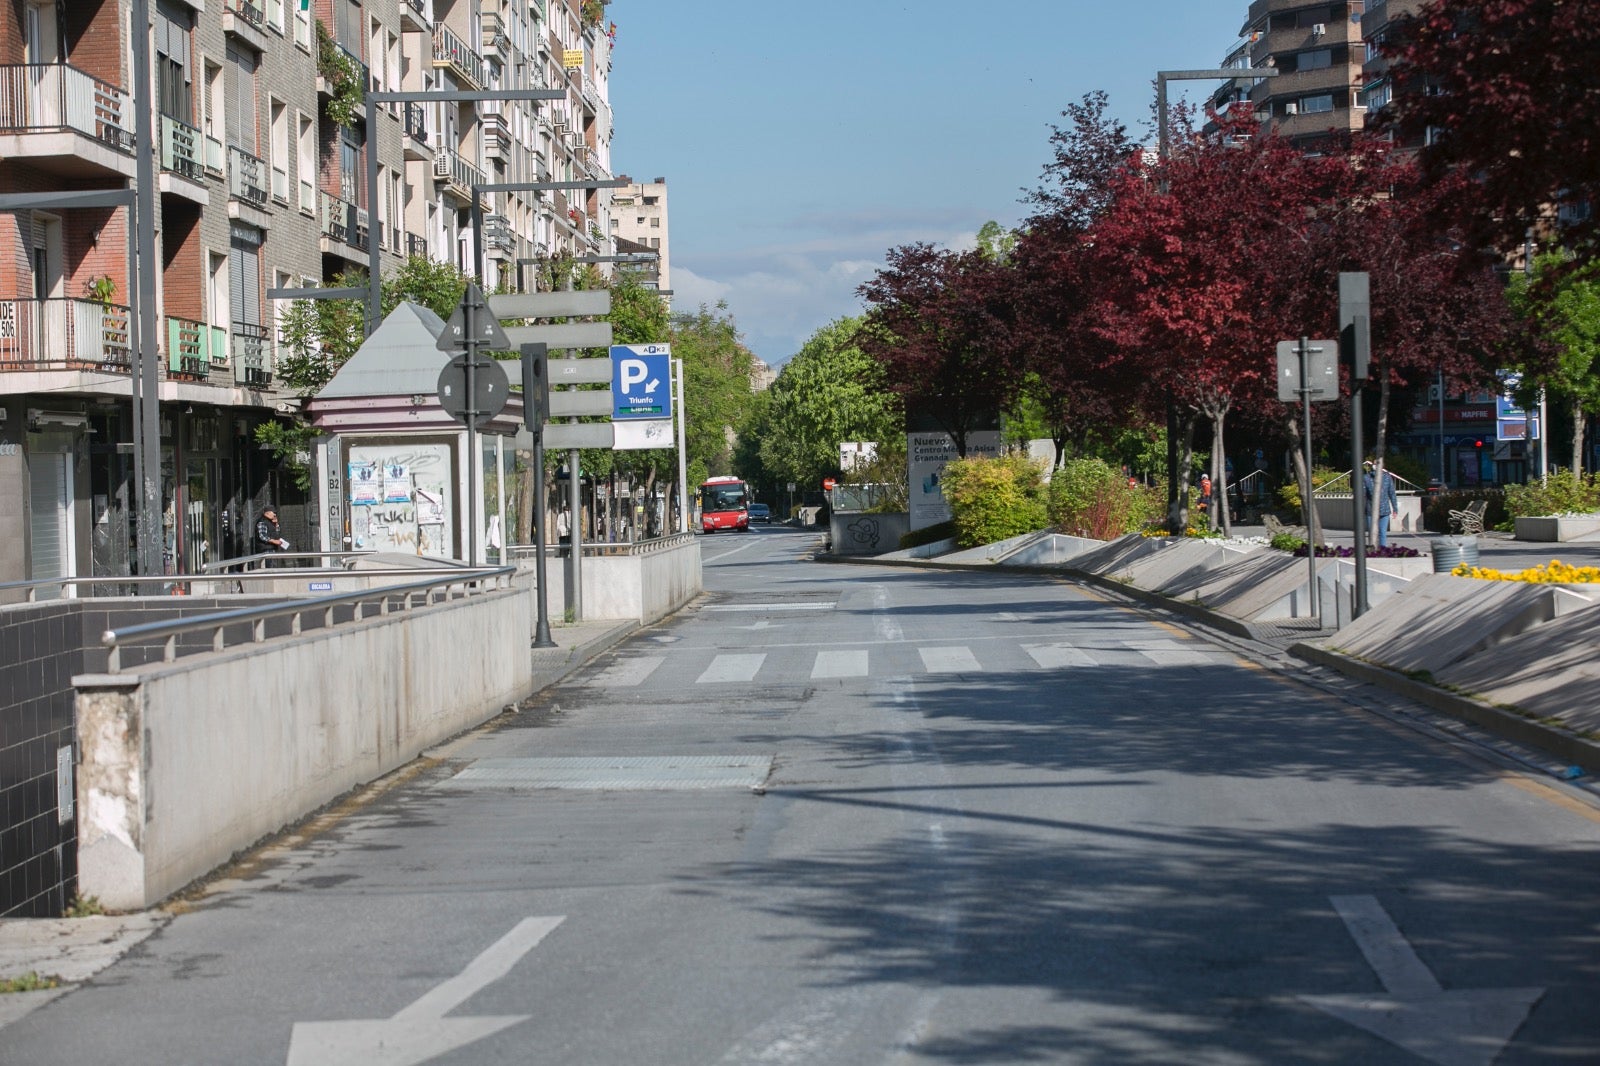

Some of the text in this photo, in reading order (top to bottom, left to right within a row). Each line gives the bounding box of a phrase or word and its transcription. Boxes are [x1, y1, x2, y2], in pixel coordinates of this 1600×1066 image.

[0, 302, 14, 320] DE
[1, 320, 15, 337] 506
[620, 359, 649, 395] P
[914, 438, 946, 446] Nuevo
[914, 446, 942, 454] Centro
[329, 479, 339, 489] B2
[330, 505, 340, 516] C1
